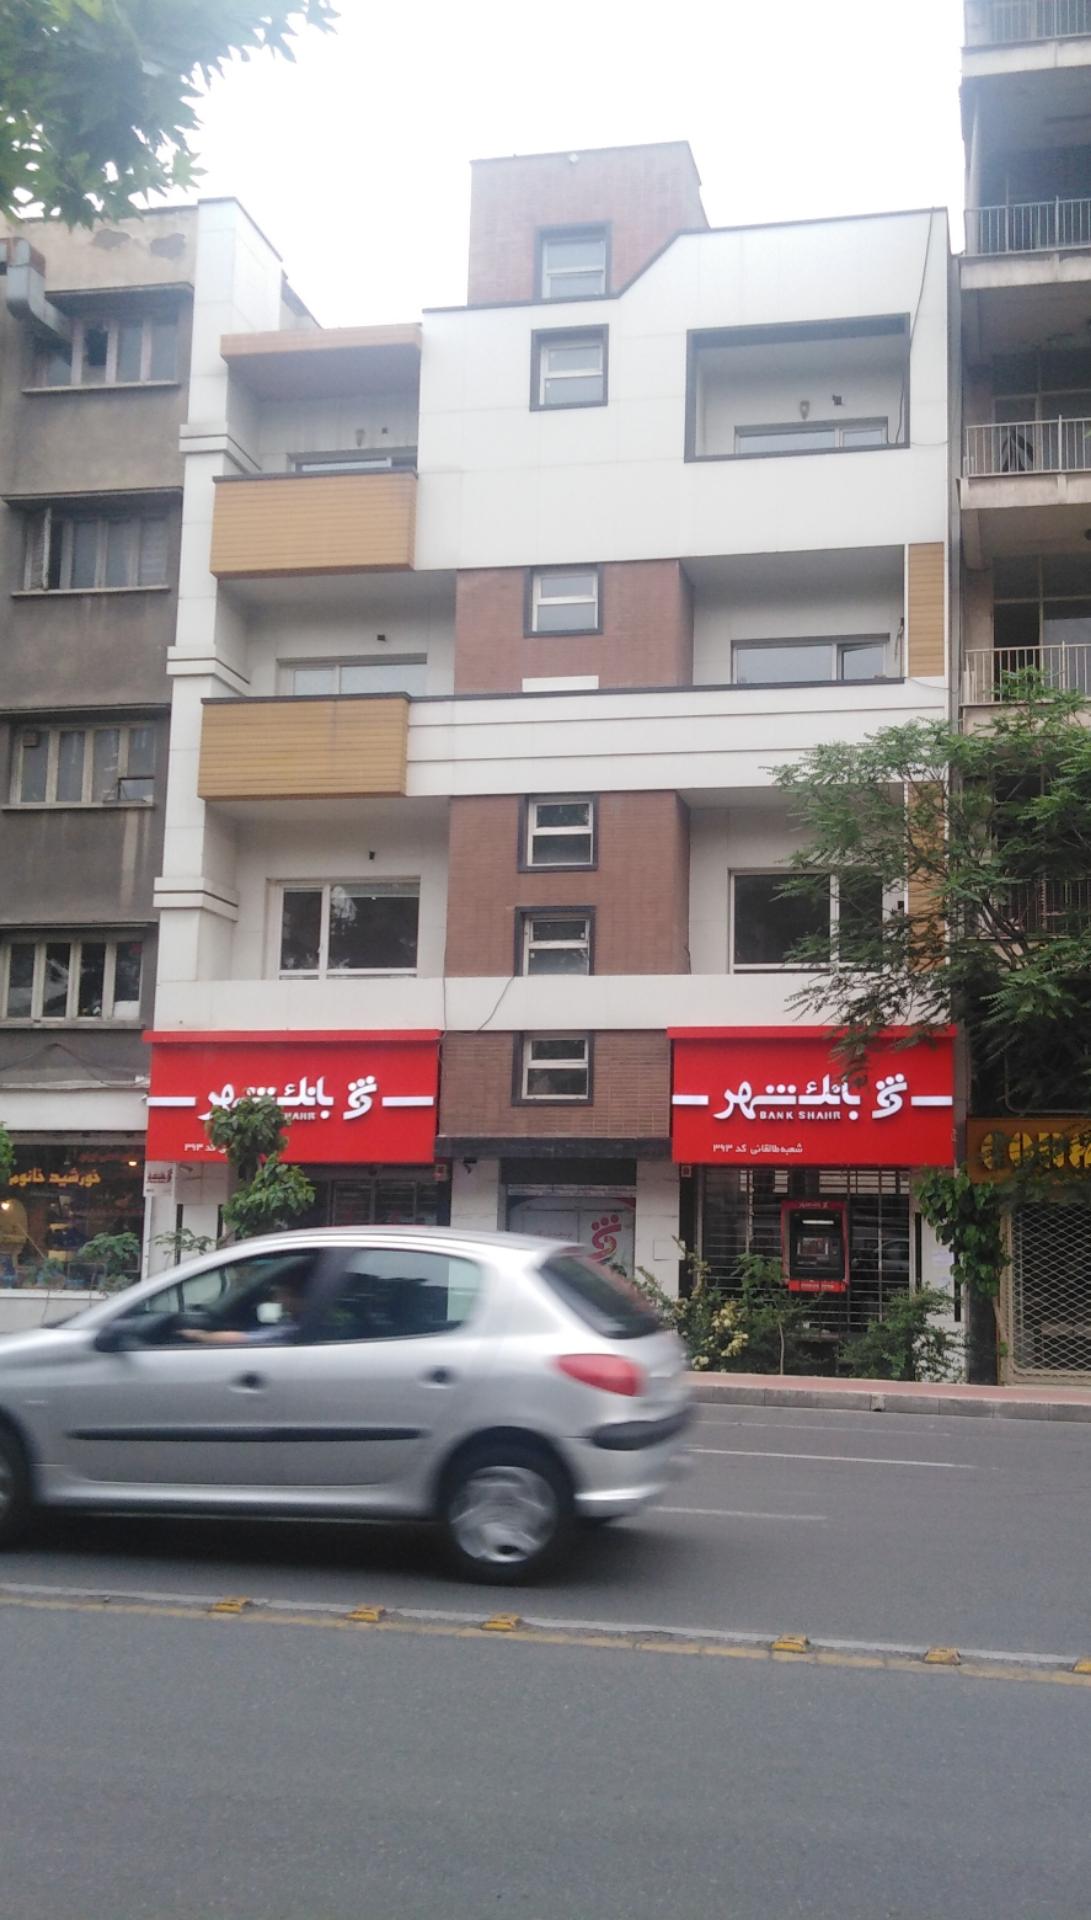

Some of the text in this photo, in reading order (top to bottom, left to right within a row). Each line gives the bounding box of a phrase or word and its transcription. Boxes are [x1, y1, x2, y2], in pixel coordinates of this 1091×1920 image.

[713, 1073, 861, 1120] بانک شهر
[283, 1111, 316, 1121] HAHR
[759, 1110, 842, 1120] BANK SHAHR
[735, 1143, 747, 1153] کد
[9, 1167, 101, 1188] خورشید خانوم
